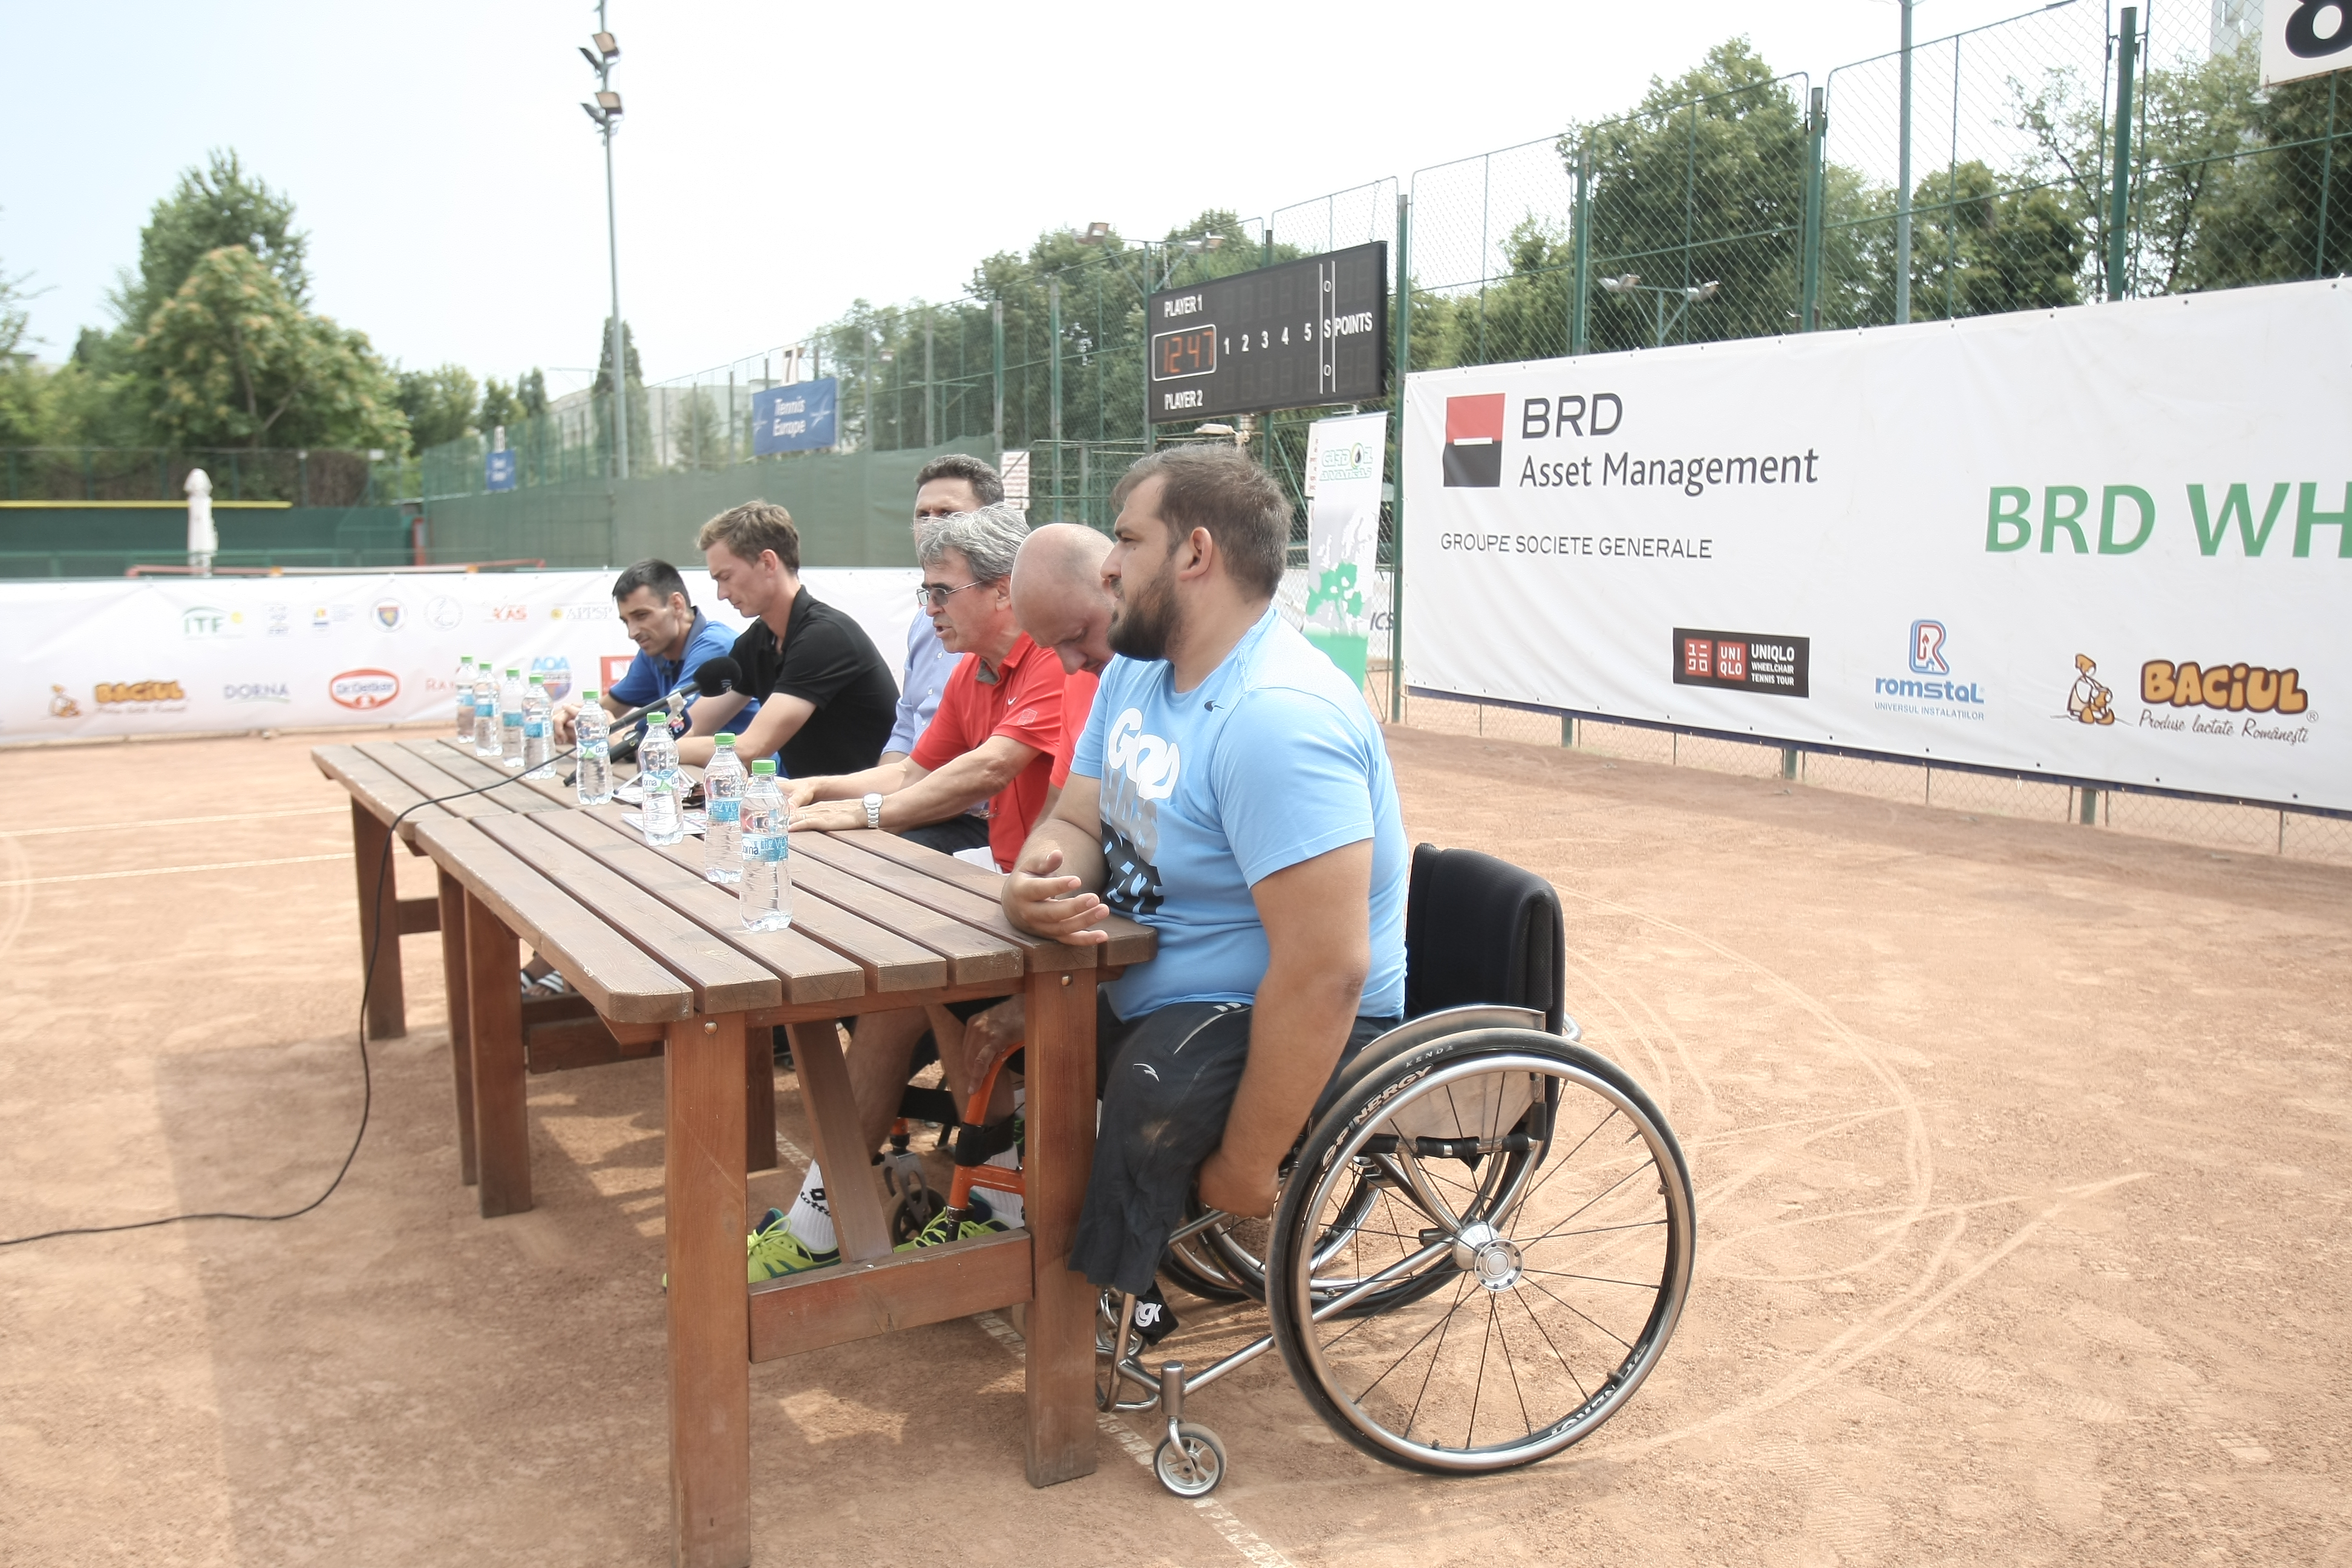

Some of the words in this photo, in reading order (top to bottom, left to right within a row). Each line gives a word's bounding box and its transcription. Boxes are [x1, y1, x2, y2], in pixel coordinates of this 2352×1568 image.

[1164, 295, 1196, 318] PLAYER
[1197, 294, 1203, 311] 1
[1223, 338, 1230, 354] 1
[1241, 335, 1249, 352] 2
[1261, 331, 1269, 349] 3
[1281, 327, 1289, 345] 4
[1304, 322, 1312, 341] 5
[1335, 312, 1373, 337] POINTS
[774, 396, 806, 416] Tennis
[1164, 391, 1196, 410] PLAYER
[1196, 390, 1203, 407] 2
[1521, 392, 1624, 439] BRD
[773, 419, 806, 438] Europe
[1519, 454, 1592, 488] Asset
[1602, 448, 1819, 497] Management
[1985, 484, 2157, 555] BRD
[1440, 532, 1511, 553] GROUPE
[1515, 535, 1593, 555] SOCIETE
[1598, 536, 1713, 559] GENERALE
[1720, 645, 1741, 661] UNI
[1751, 643, 1795, 663] UNIQLO
[1720, 662, 1742, 677] QLO
[1751, 661, 1795, 675] WHEELCHAIR
[1751, 673, 1775, 684] TENNIS
[1776, 675, 1795, 686] TOUR
[1874, 701, 1919, 714] UNIVERSUL
[2138, 708, 2186, 731] Produse
[2191, 714, 2234, 736] lactate
[1405, 1045, 1454, 1068] KENDA
